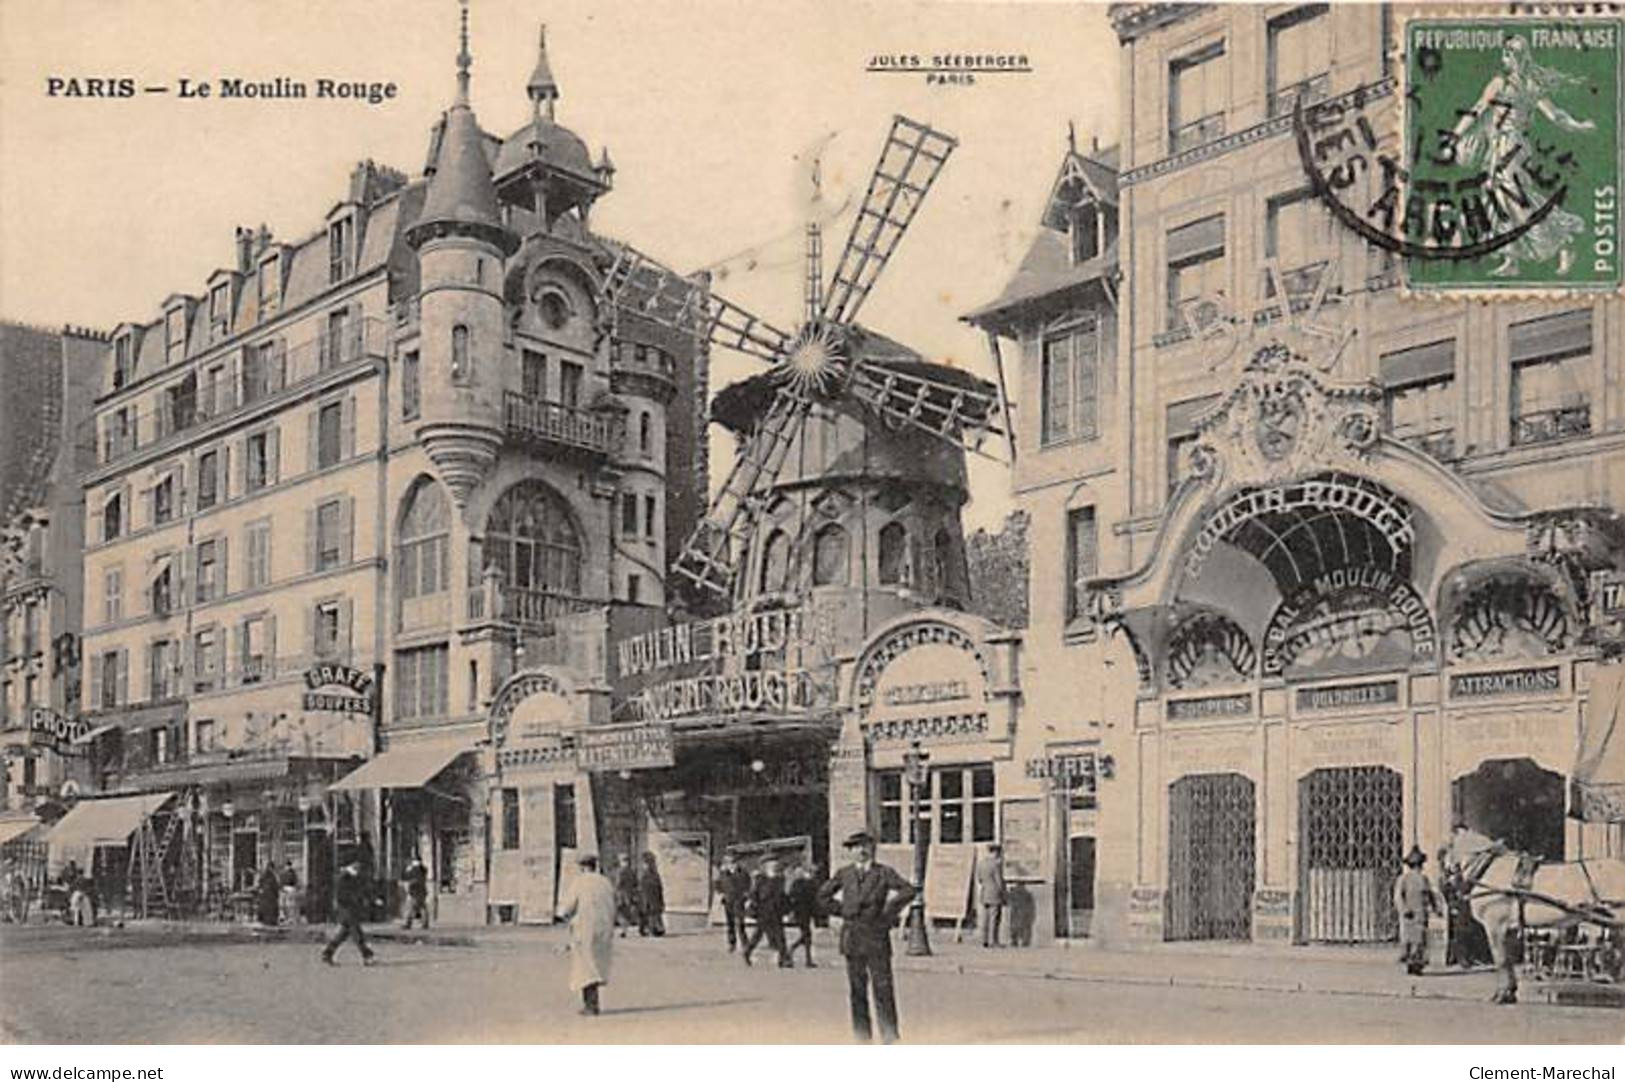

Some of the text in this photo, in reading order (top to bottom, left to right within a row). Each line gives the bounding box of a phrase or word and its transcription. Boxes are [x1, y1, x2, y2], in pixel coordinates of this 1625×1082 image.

[1593, 184, 1616, 272] POSTES
[1183, 480, 1415, 578] MOULIN ROUGE
[1268, 603, 1301, 643] BAL
[1313, 566, 1393, 597] MOULIN
[1390, 583, 1435, 656] ROUGE
[32, 708, 89, 743] PHOTO
[1457, 668, 1558, 695] ATTRACTIONS
